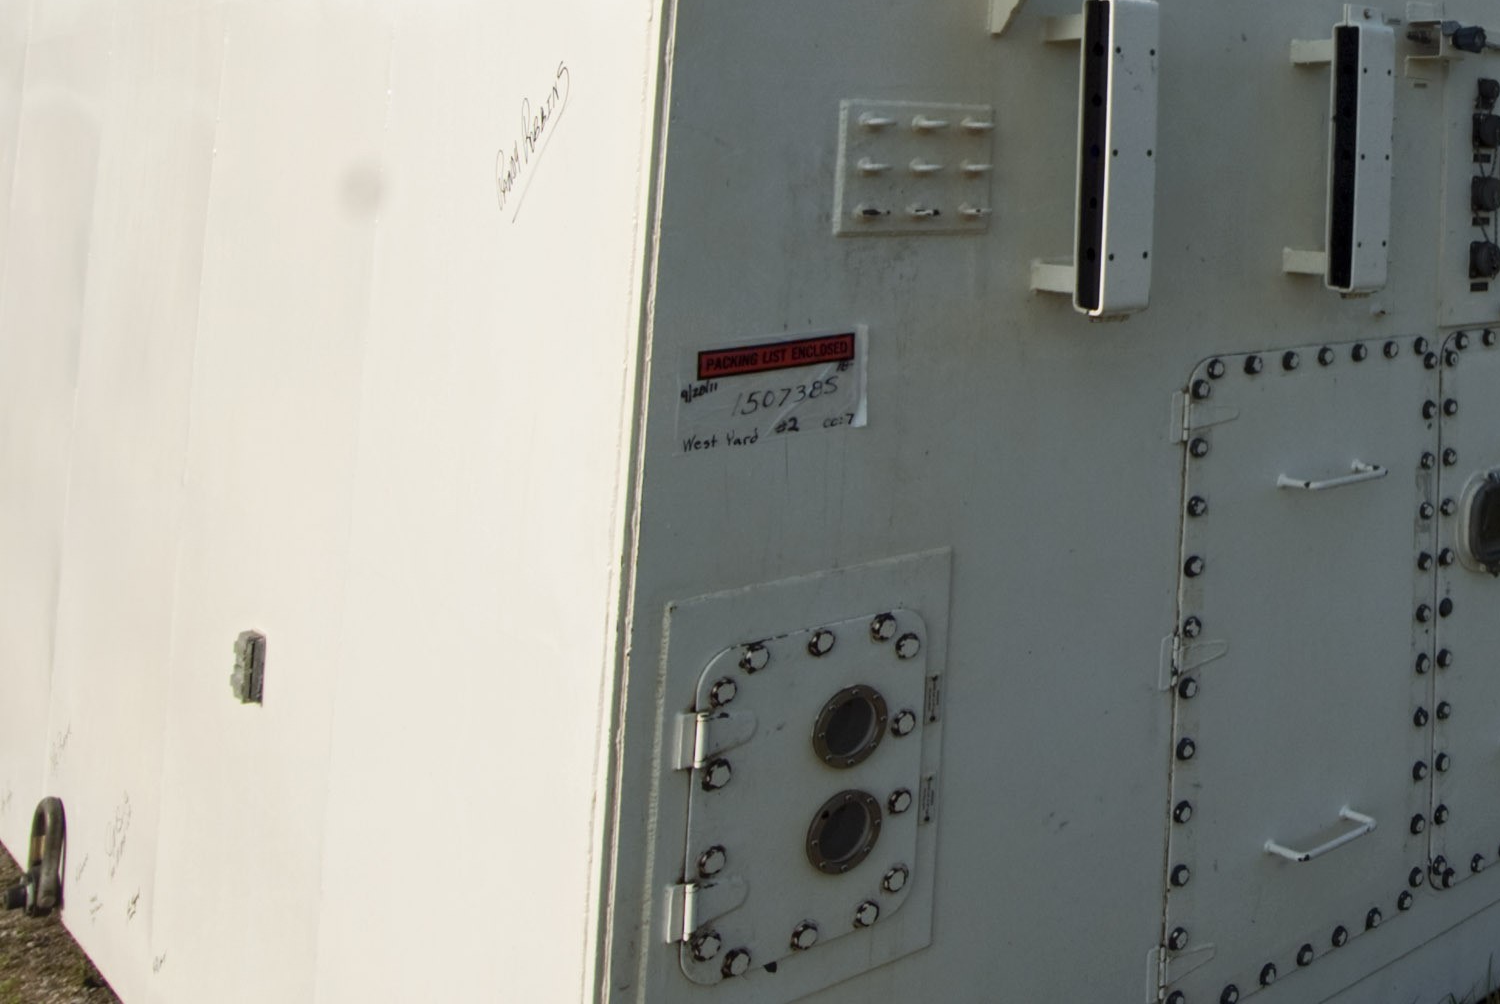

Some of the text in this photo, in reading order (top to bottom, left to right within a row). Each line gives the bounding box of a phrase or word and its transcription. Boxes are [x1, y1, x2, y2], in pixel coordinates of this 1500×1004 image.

[706, 339, 849, 372] PACKING LIST ENCLOSED
[682, 433, 718, 453] West
[725, 427, 760, 447] Yard
